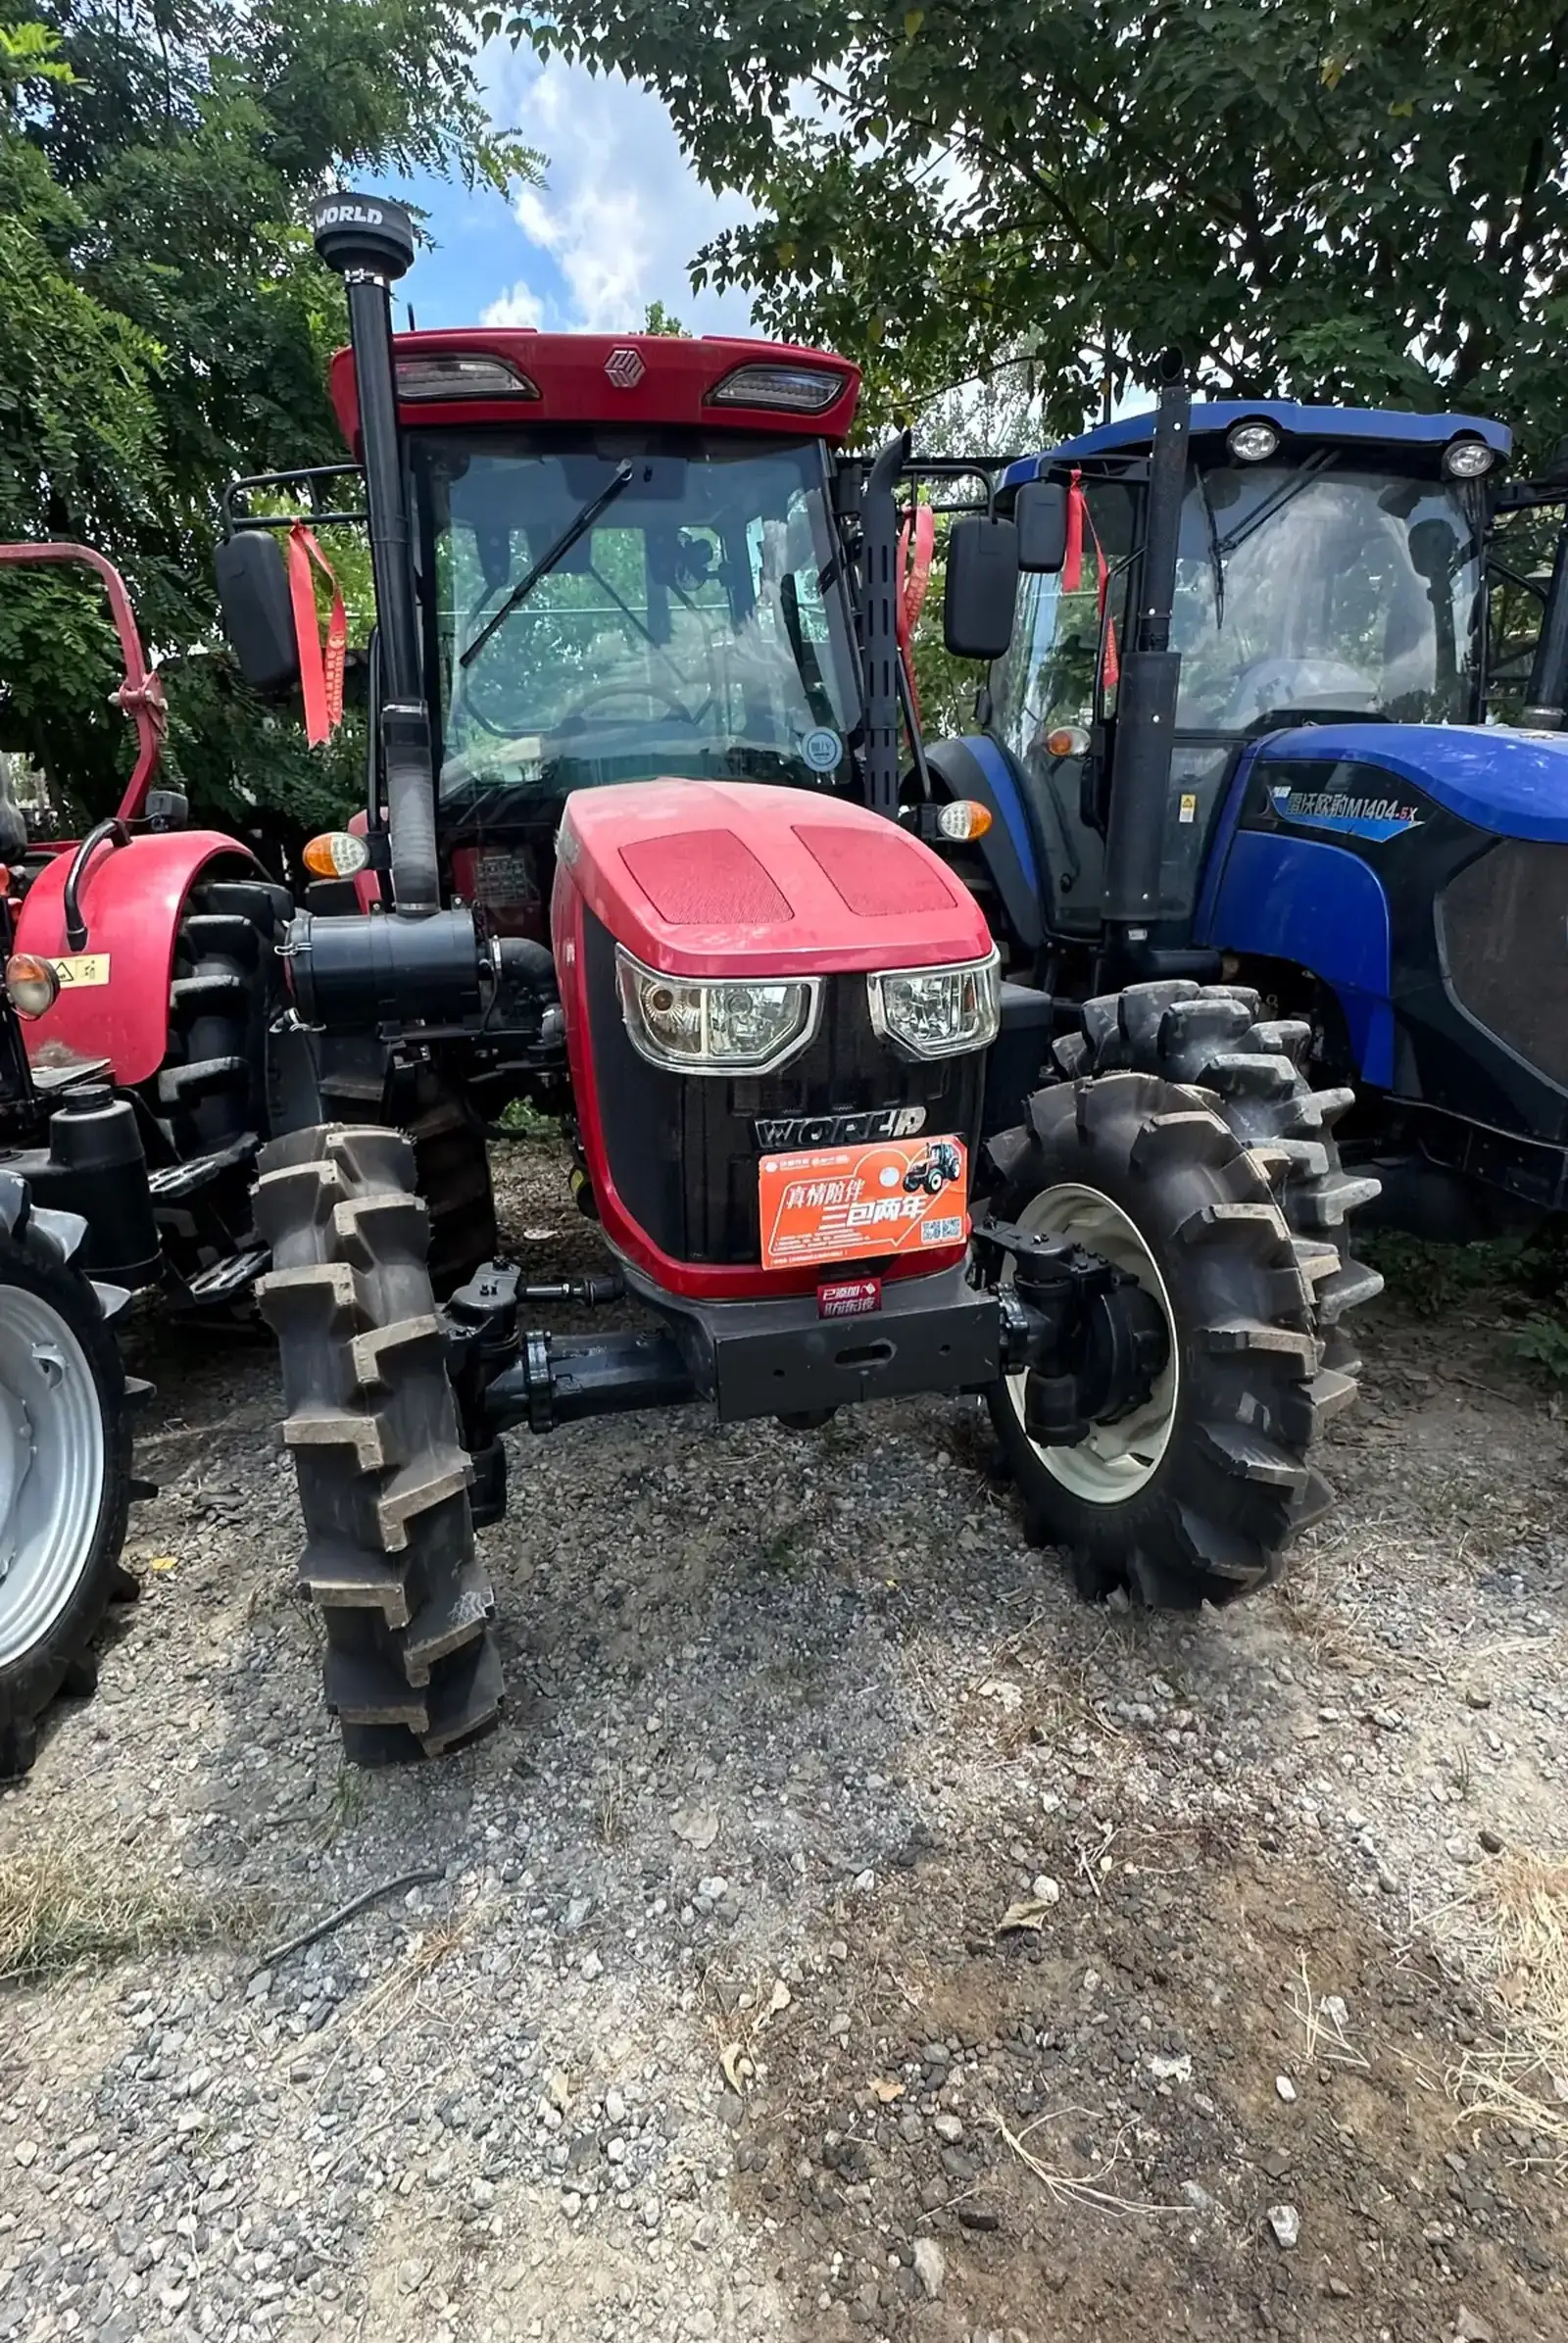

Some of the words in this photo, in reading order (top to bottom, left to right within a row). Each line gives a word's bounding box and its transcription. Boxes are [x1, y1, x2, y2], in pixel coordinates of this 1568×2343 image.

[755, 1106, 927, 1148] WORLD
[786, 1179, 866, 1209] 真情陪伴
[817, 1195, 927, 1231] 三包两年
